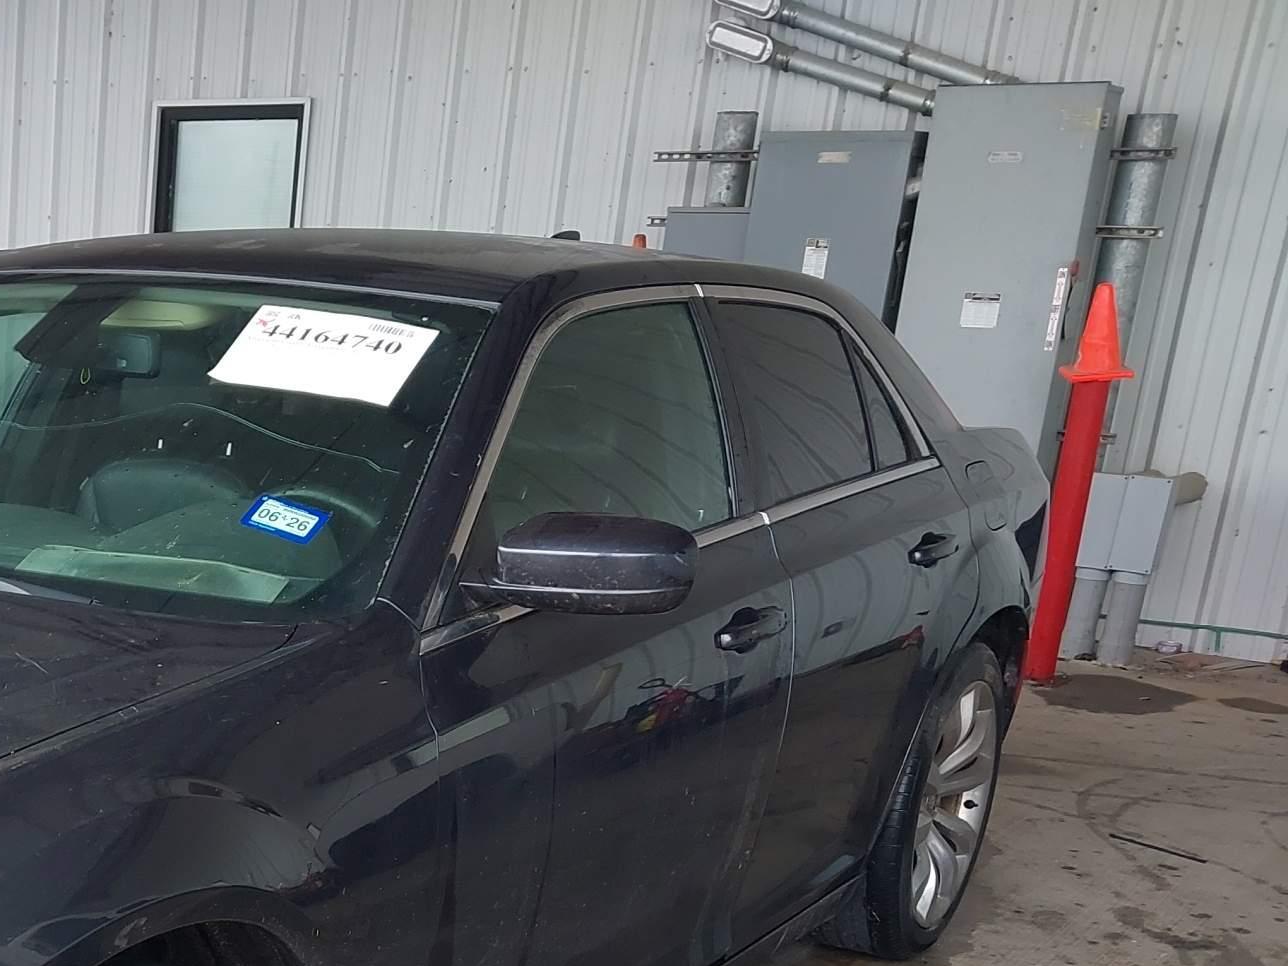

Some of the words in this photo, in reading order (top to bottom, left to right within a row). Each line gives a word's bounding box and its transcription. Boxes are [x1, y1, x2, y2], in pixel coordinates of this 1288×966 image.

[262, 324, 402, 355] 44164740
[257, 508, 282, 522] 06
[285, 517, 310, 531] 26
